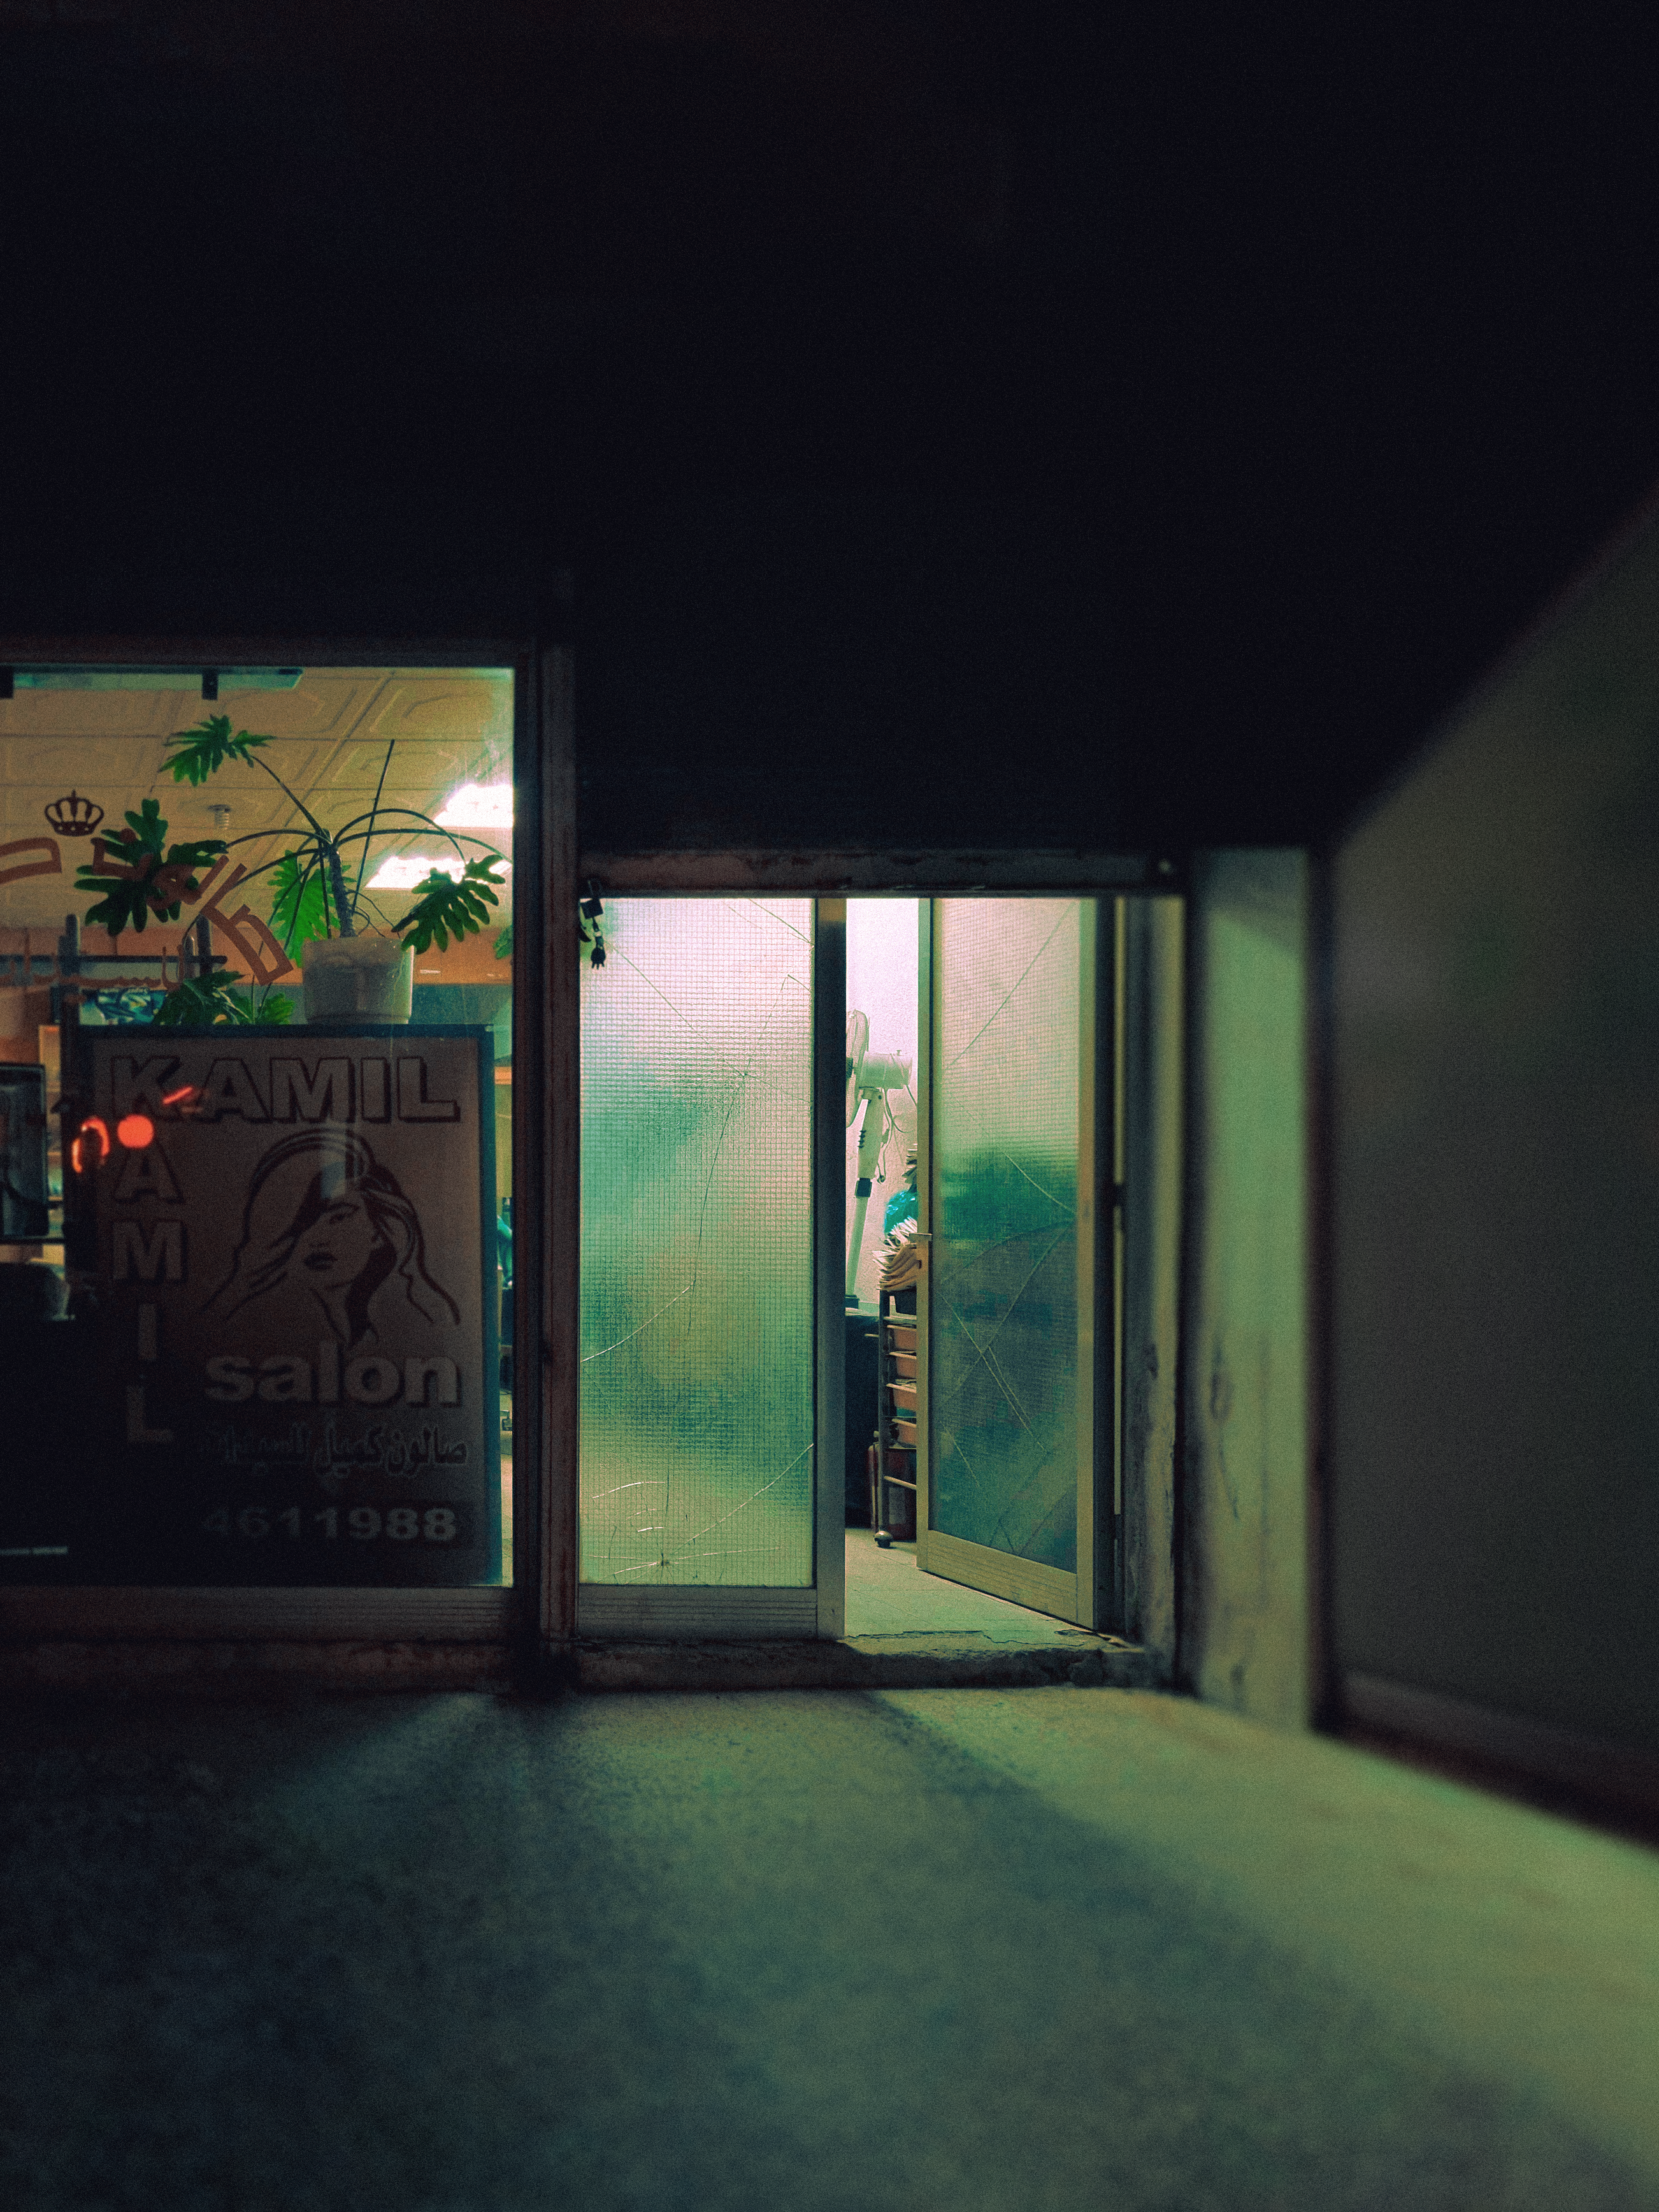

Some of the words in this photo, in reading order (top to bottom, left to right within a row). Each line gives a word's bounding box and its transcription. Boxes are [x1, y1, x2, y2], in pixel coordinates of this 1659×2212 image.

[110, 1055, 461, 1123] KAMIL
[204, 1342, 461, 1406] salon
[313, 1421, 384, 1478] كميل
[384, 1426, 468, 1478] صالون
[201, 1506, 457, 1542] 4611988
